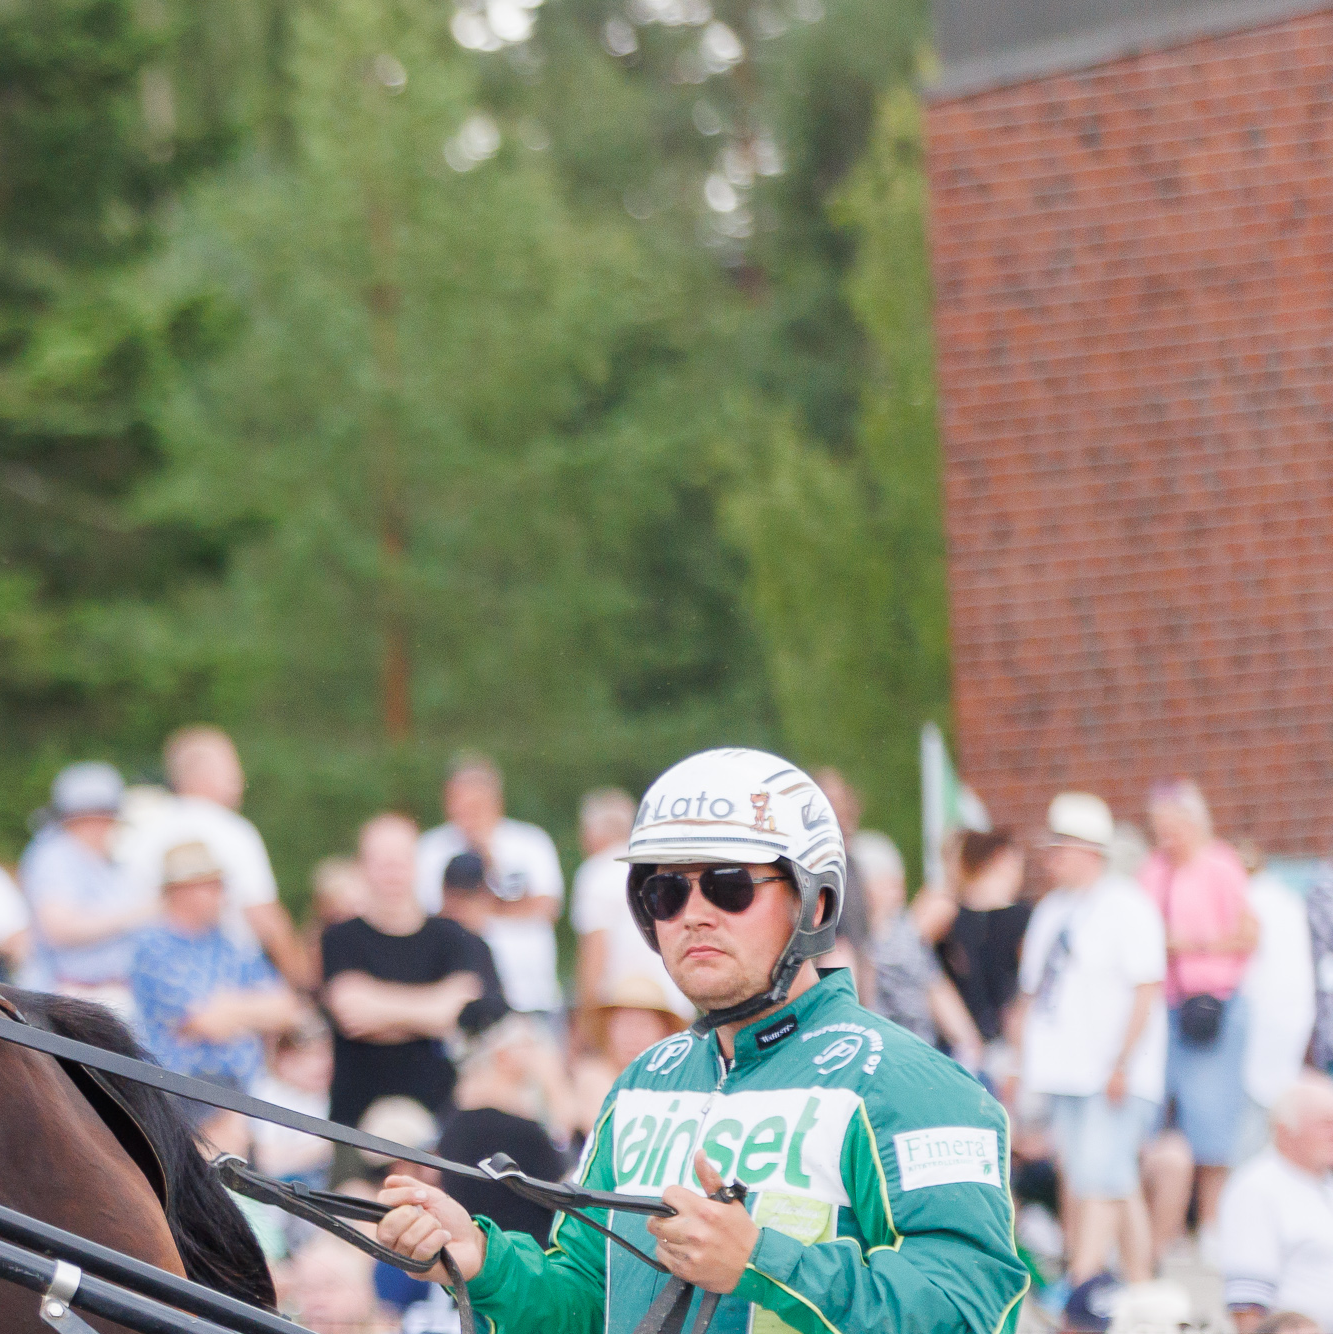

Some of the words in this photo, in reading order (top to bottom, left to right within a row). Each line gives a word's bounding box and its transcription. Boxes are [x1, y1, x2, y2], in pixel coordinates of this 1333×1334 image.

[652, 791, 734, 821] Lato
[617, 1096, 821, 1189] ainset
[904, 1134, 986, 1162] Finera
